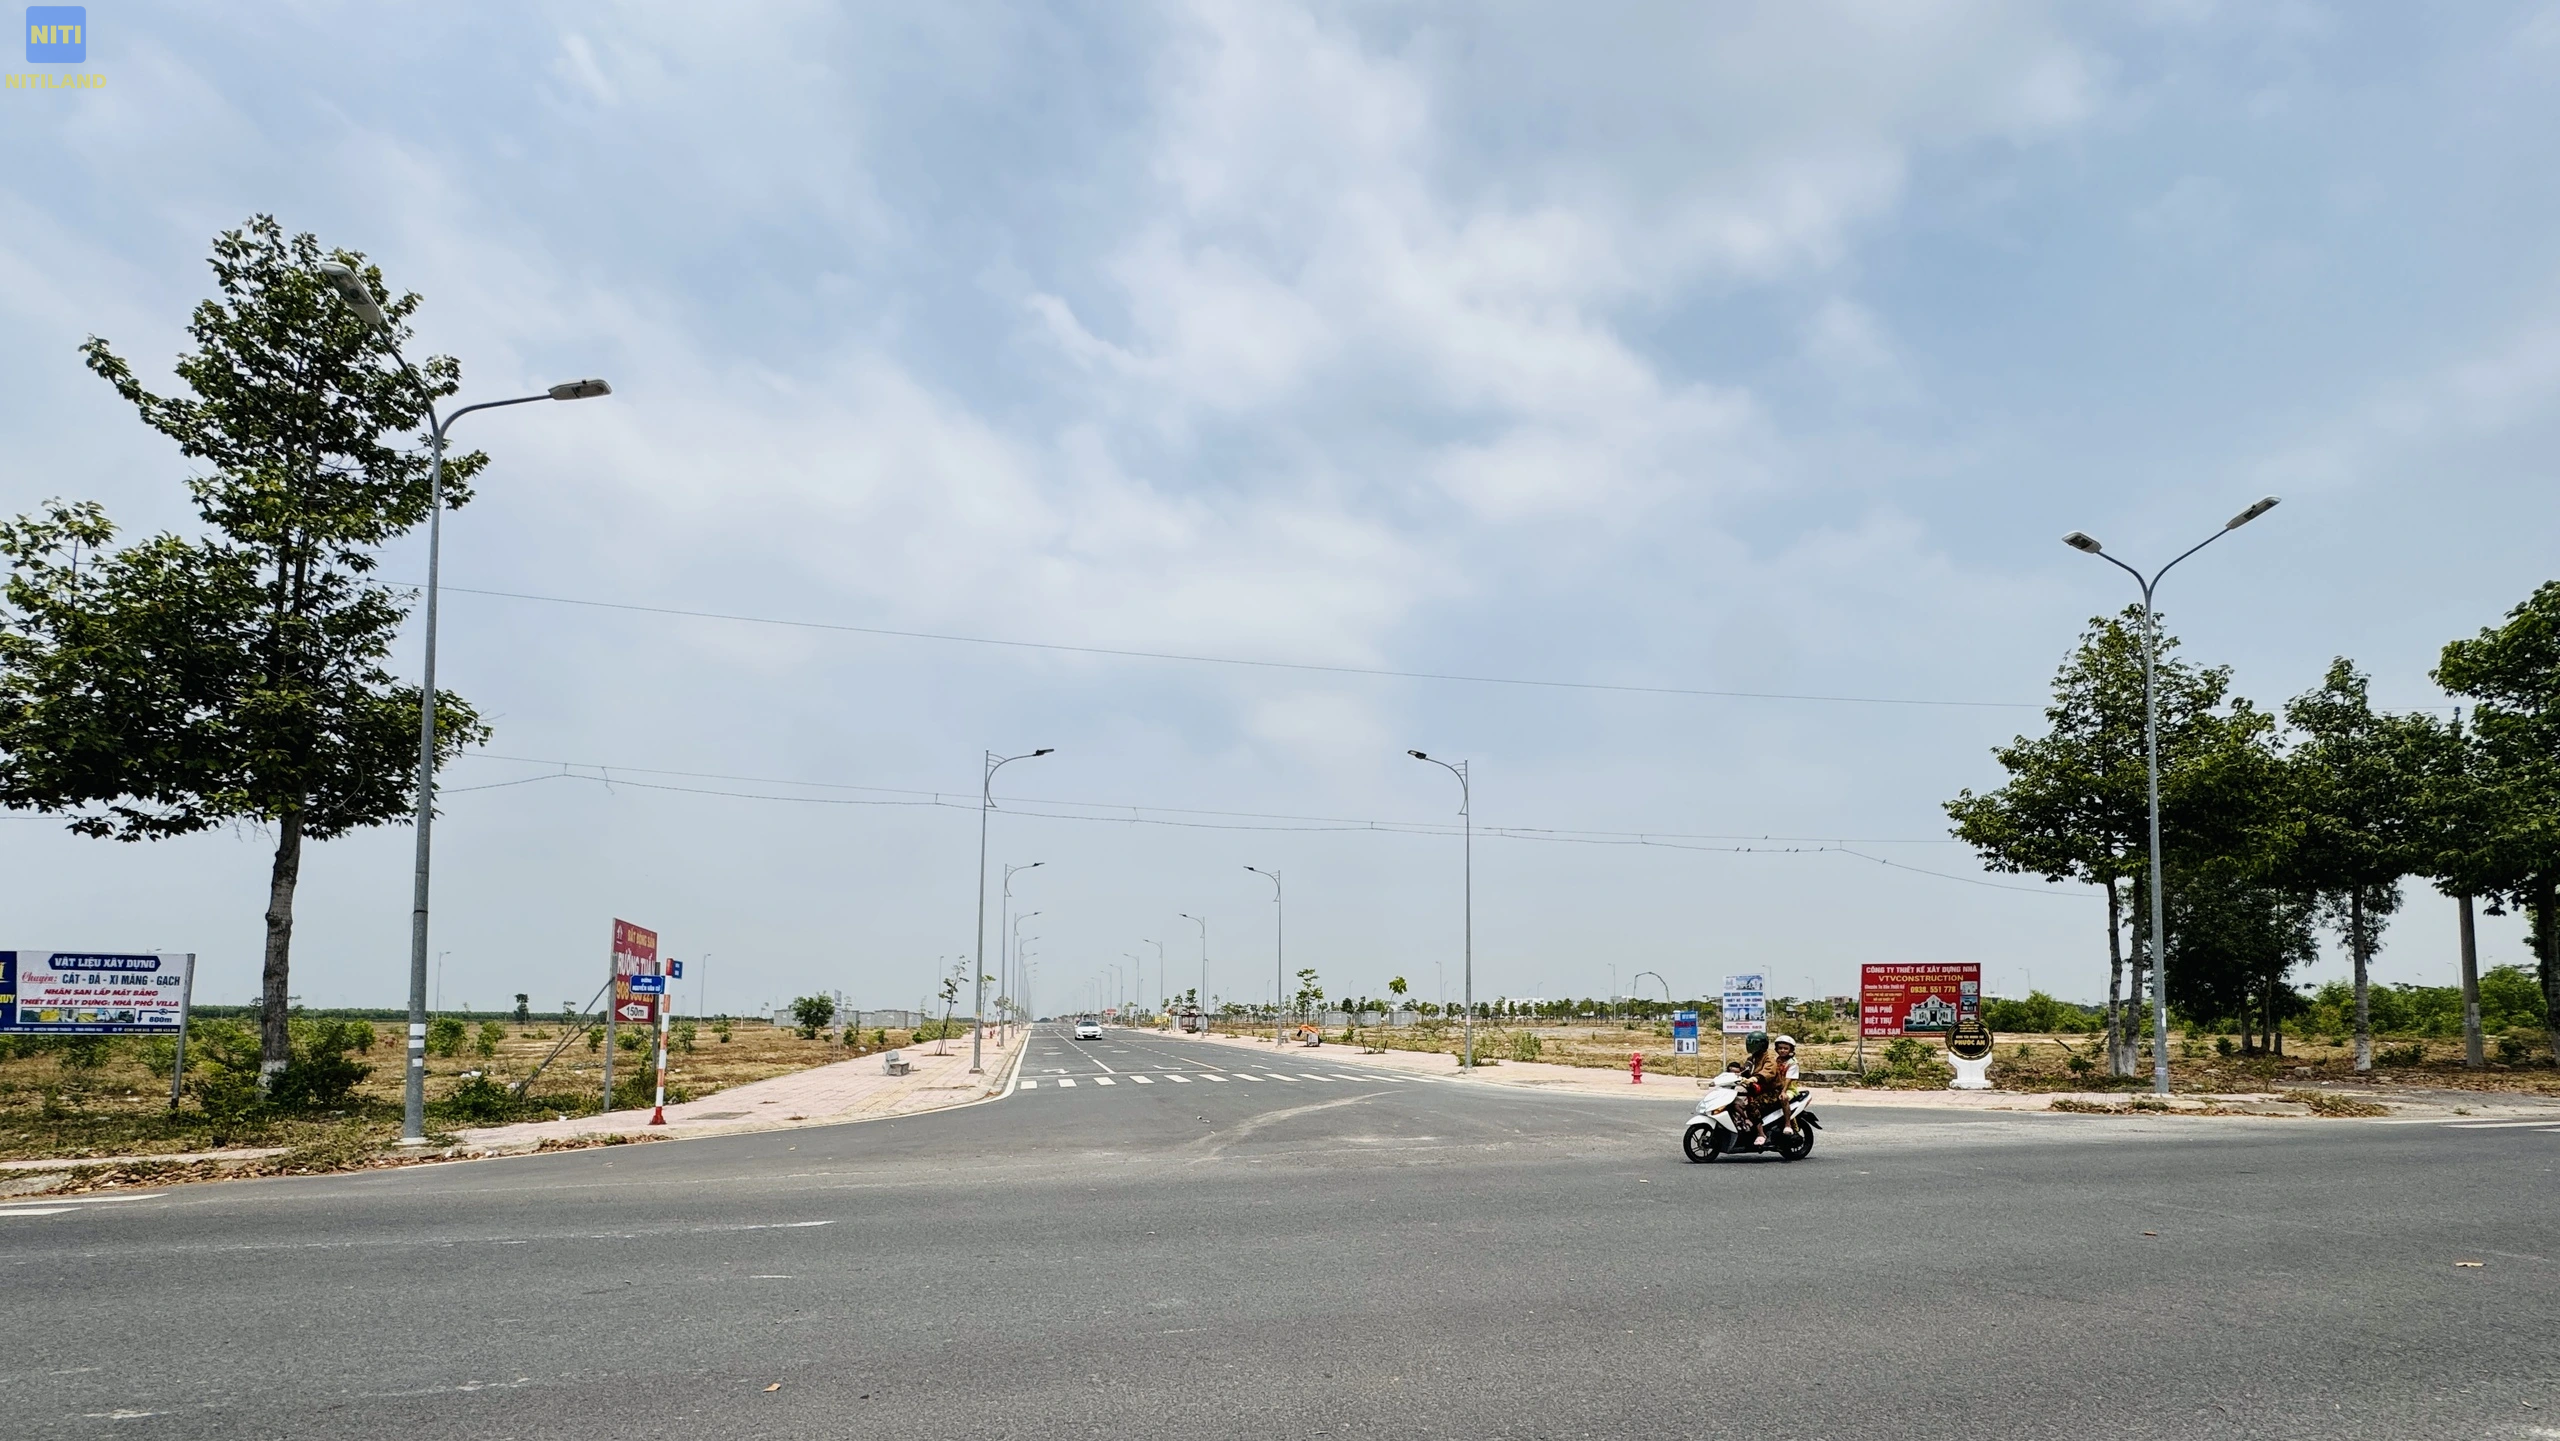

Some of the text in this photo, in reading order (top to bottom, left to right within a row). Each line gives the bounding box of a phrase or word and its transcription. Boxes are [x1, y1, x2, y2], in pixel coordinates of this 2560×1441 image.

[54, 956, 155, 970] VẬT LIỆU XÂY DỰNG
[1866, 966, 1885, 974] CÔNG
[1916, 965, 1925, 973] KẾ
[1927, 965, 1940, 973] XÂY
[1942, 965, 1961, 974] DỰNG
[1963, 965, 1977, 973] NHÀ
[62, 972, 80, 985] CÁT
[88, 972, 101, 985] ĐÁ
[109, 974, 119, 985] XI
[121, 973, 148, 986] MĂNG
[156, 975, 180, 988] GẠCH
[20, 997, 43, 1005] THIẾT
[46, 997, 59, 1005] KẾ
[60, 997, 80, 1006] XÂY
[134, 999, 154, 1007] PHỐ
[626, 1006, 645, 1017] 150m
[1865, 1004, 1893, 1013] NHÀ PHỐ
[1865, 1016, 1893, 1026] BIỆT THỰ
[1864, 1027, 1886, 1035] KHÁCH
[1887, 1028, 1901, 1037] SẠN
